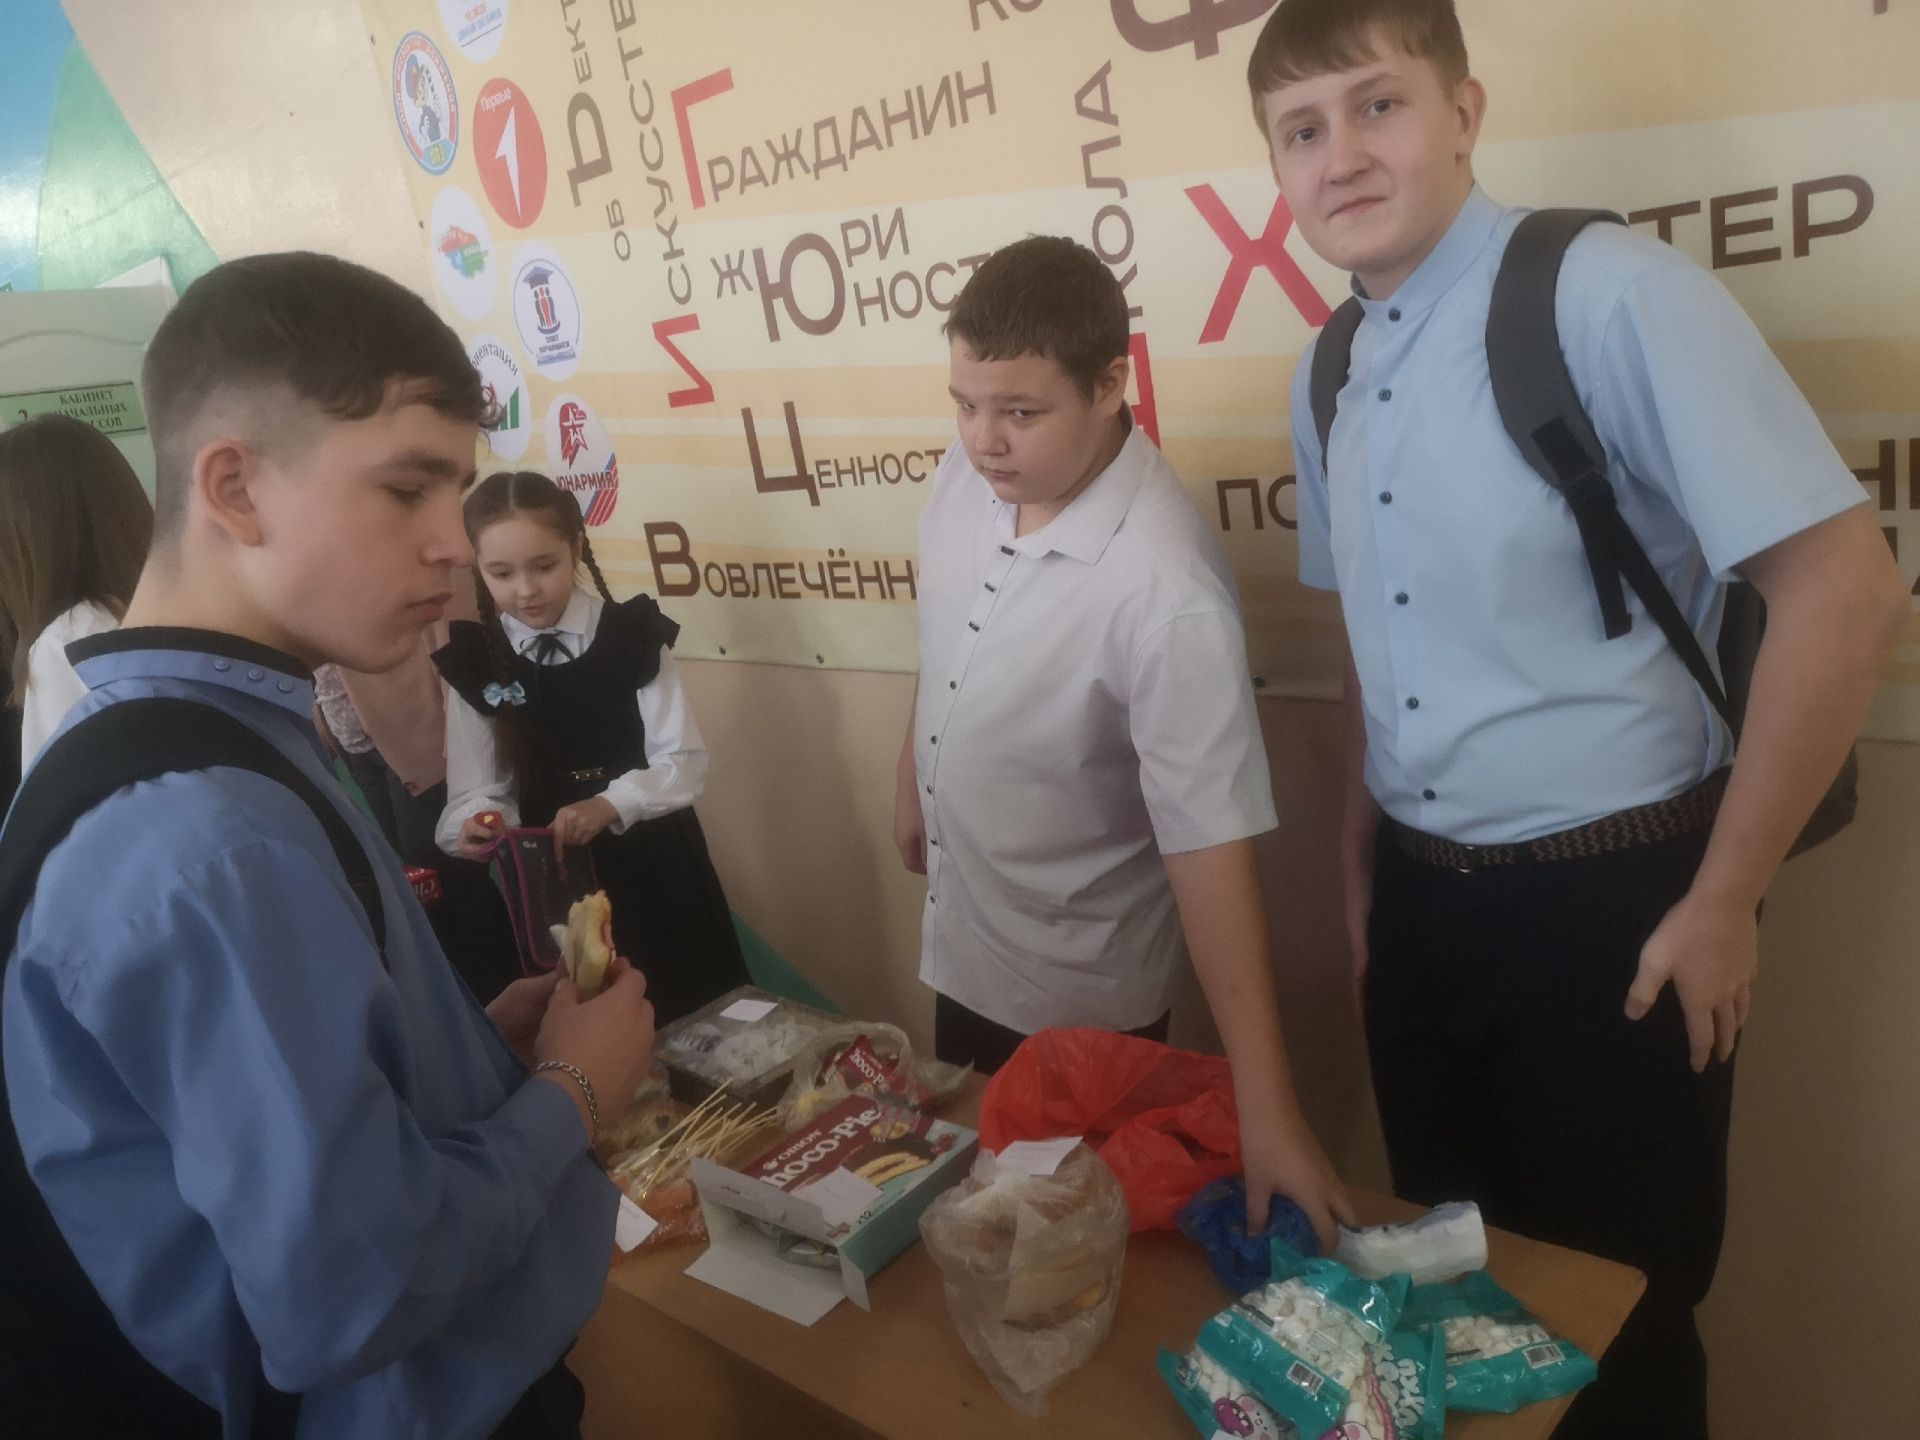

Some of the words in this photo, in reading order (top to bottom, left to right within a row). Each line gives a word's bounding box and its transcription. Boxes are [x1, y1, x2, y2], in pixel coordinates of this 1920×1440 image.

[671, 61, 997, 209] ГРАЖДАНИН
[60, 390, 113, 405] КАБИНЕТ
[643, 521, 919, 601] ВОВЛЕЧЁНН
